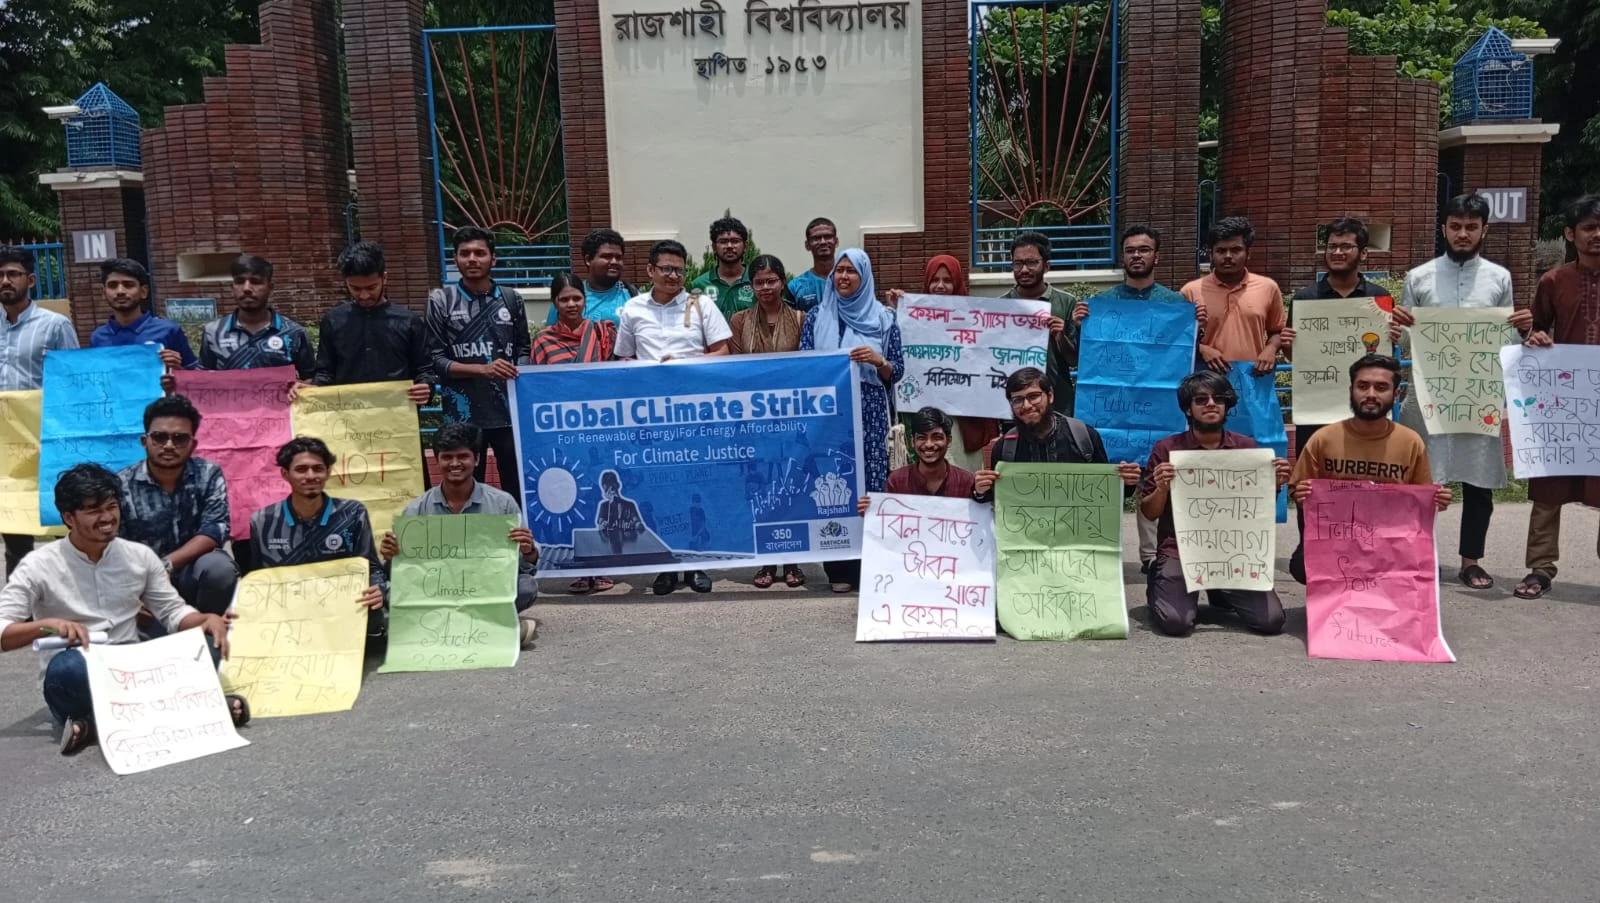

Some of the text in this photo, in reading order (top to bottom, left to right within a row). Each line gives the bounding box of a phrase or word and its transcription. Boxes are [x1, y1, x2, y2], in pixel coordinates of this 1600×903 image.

[612, 0, 910, 40] রাজশাহী বিশ্ববিদ্যালয়
[764, 54, 827, 75] ১৯৫৩
[1482, 191, 1523, 220] OUT
[83, 234, 107, 259] IN
[945, 328, 983, 344] নয়
[535, 389, 836, 430] Global CLimate Strike
[558, 434, 575, 444] For
[579, 430, 636, 443] Renewable
[700, 424, 736, 438] Energy
[740, 420, 808, 435] Affordability
[614, 444, 756, 465] For Climate Justice
[1324, 459, 1409, 479] BURBERRY
[1011, 473, 1117, 502] আমাদের
[1175, 467, 1257, 491] আমাদের
[876, 497, 921, 540] বিল
[1186, 496, 1265, 522] জেলায়
[401, 515, 468, 560] Global
[774, 528, 792, 540] 350
[1002, 505, 1118, 543] জলবায়ু
[901, 540, 959, 580] জীবন
[1005, 549, 1098, 583] আমাদের
[423, 567, 477, 598] Climate
[871, 604, 958, 629] এ কেমন
[1011, 584, 1098, 622] অধিকার
[420, 610, 489, 648] Strike
